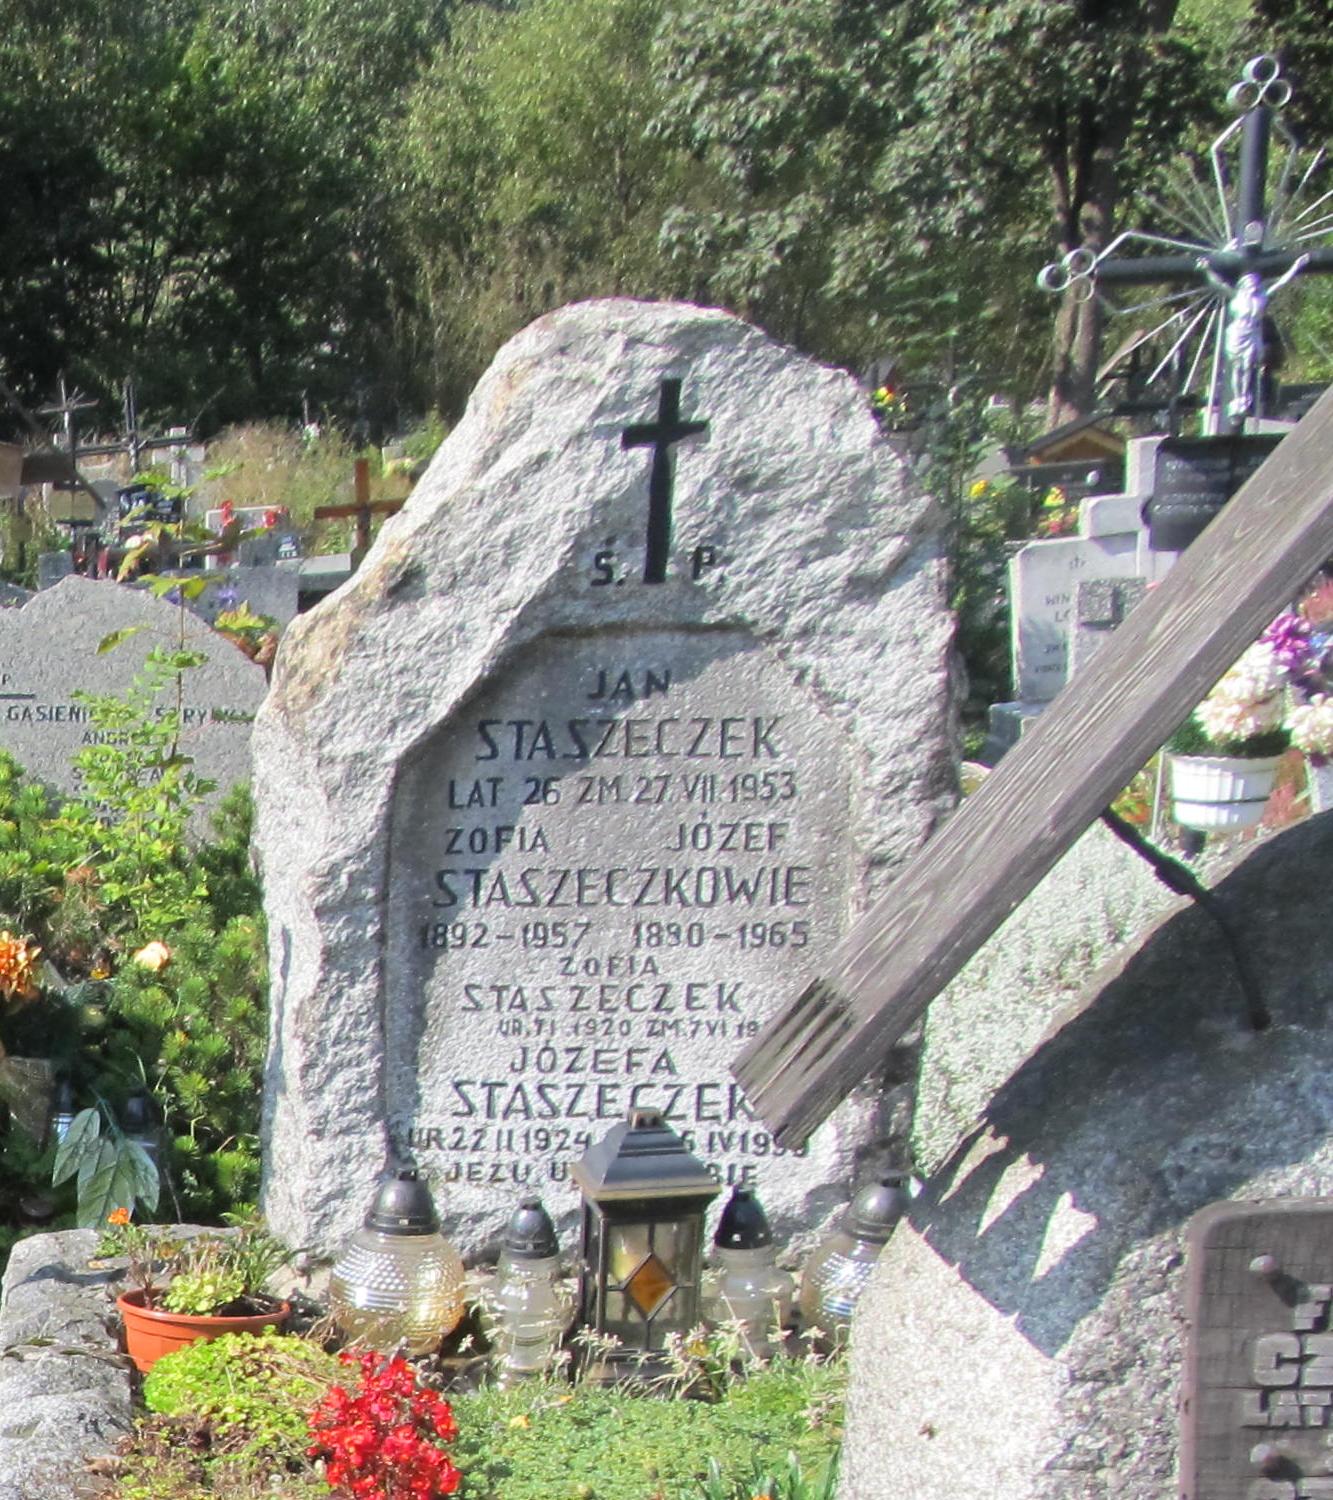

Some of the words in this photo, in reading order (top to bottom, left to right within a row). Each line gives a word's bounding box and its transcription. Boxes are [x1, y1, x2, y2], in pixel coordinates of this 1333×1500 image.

[588, 669, 671, 700] JAN
[475, 715, 785, 761] STASZECZEK
[448, 776, 504, 810] LAT
[523, 776, 561, 805] 26
[445, 827, 550, 856] ZOFIA
[667, 811, 791, 852] JÓZEF
[433, 866, 813, 910] STASZECZKOWIE
[560, 955, 660, 978] ZOFIA
[461, 982, 745, 1014] STASZECZEK
[510, 1040, 678, 1075] JÓZEFA
[451, 1078, 765, 1122] STASZECZEK
[445, 1161, 530, 1184] JEZU
[705, 1162, 759, 1188] BIE
[1241, 1388, 1332, 1427] LAT
